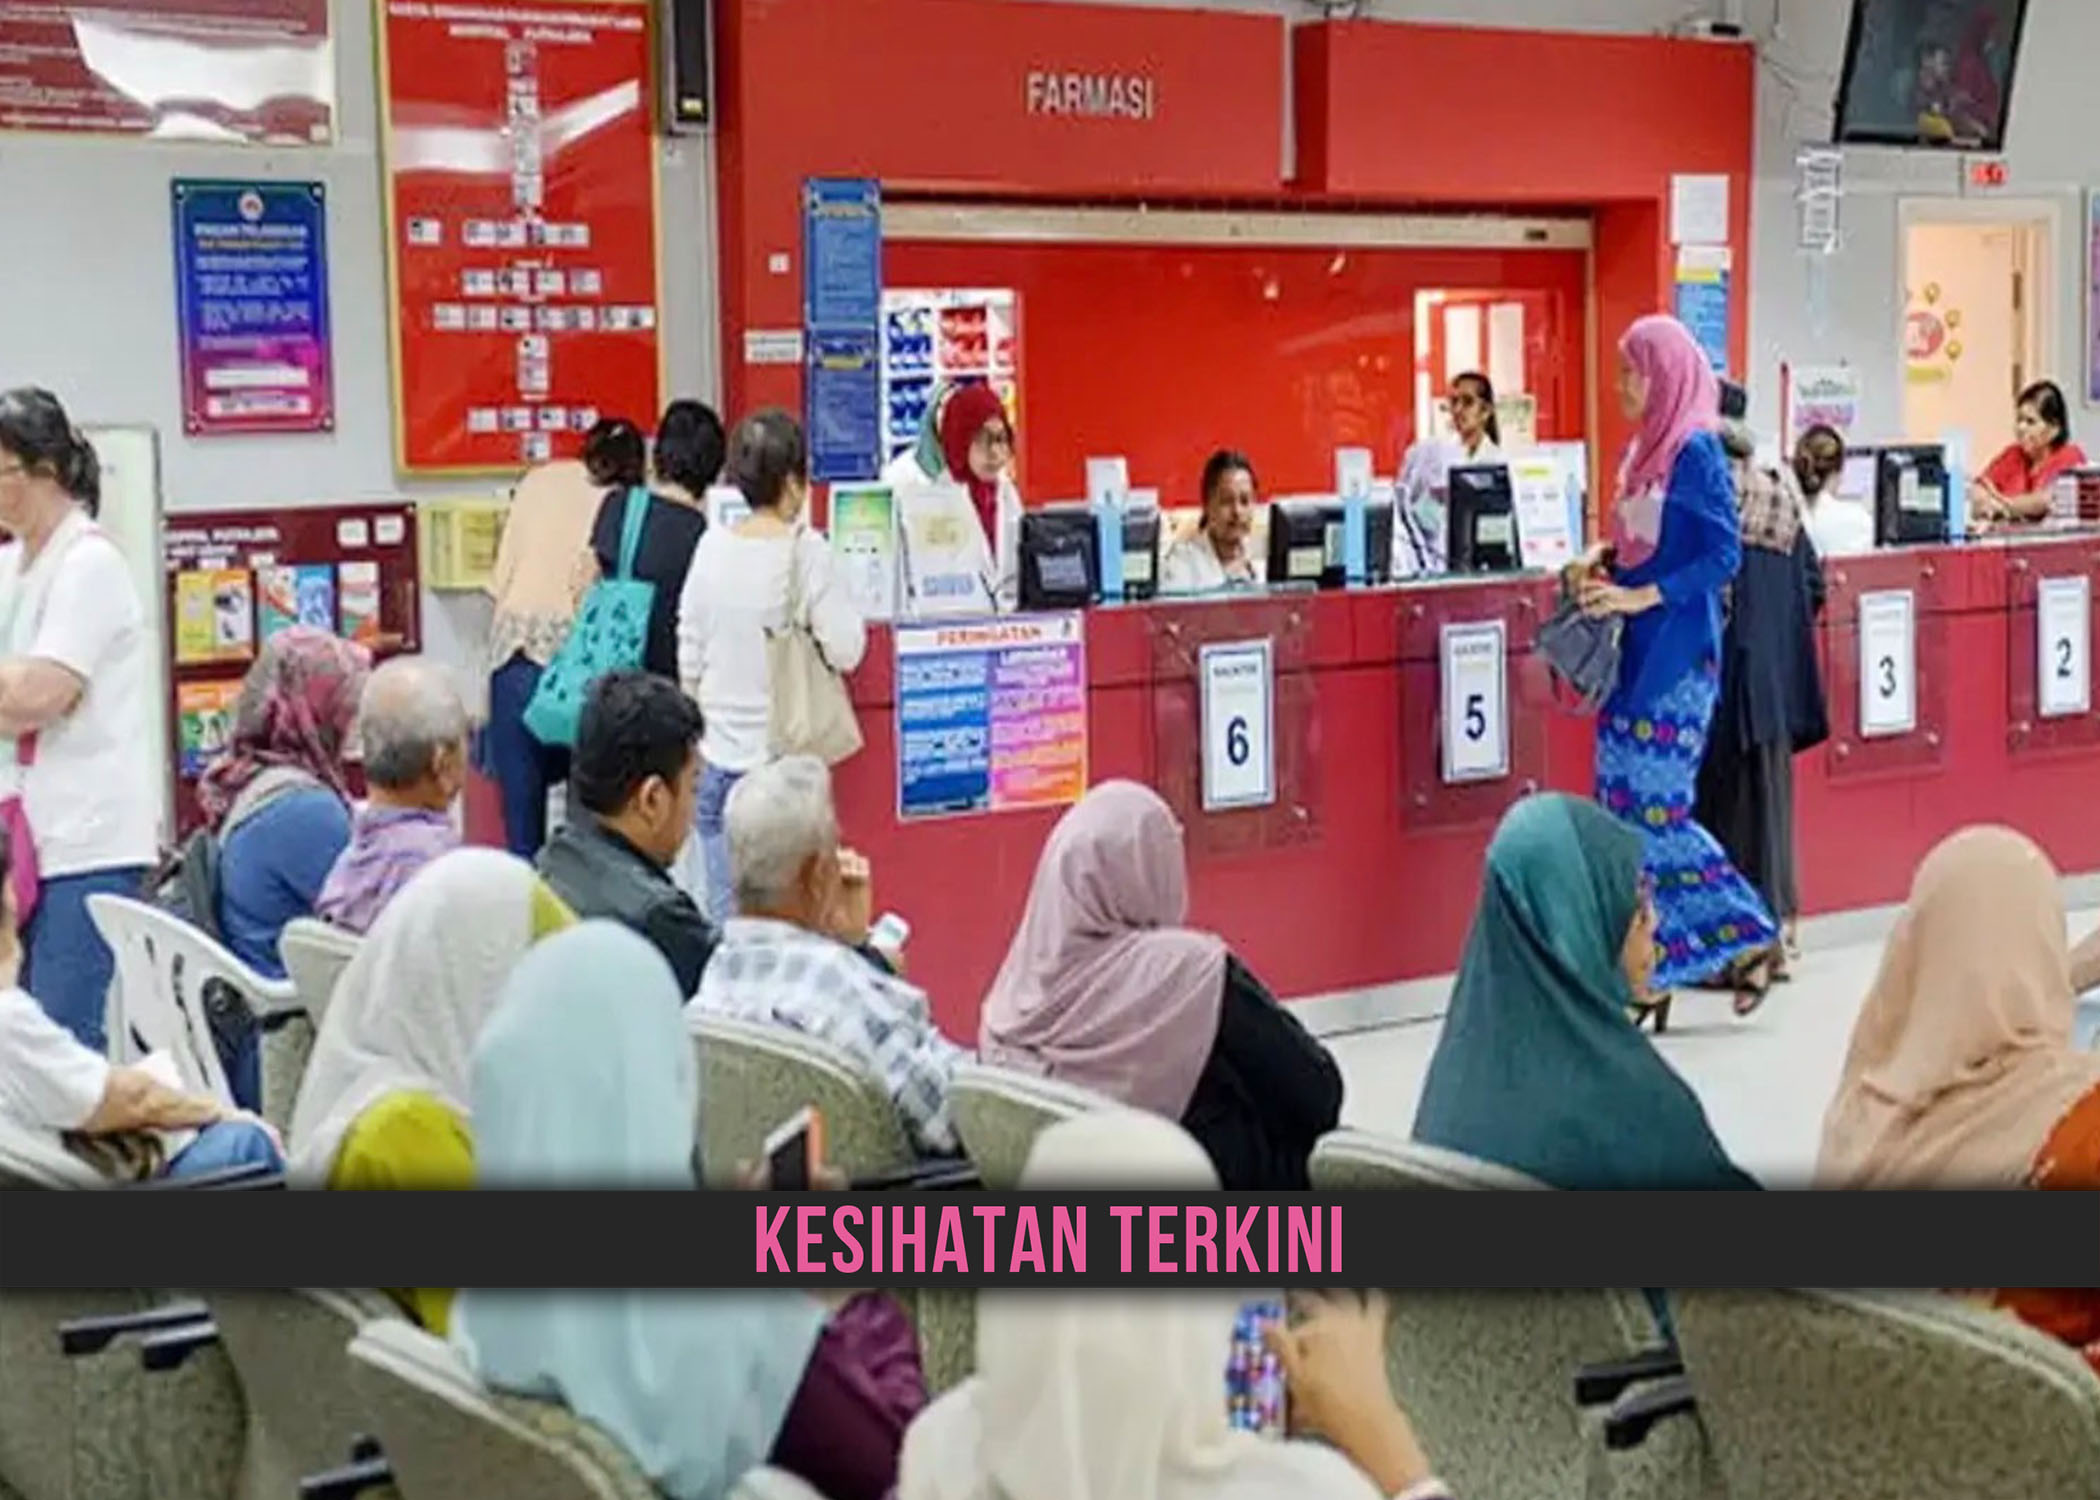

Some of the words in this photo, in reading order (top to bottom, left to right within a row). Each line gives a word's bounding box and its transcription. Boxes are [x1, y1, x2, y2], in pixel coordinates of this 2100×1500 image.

[1027, 72, 1153, 120] FARMASI
[1879, 655, 1897, 699] 3
[2056, 637, 2073, 678] 2
[1227, 715, 1250, 767] 6
[1465, 693, 1487, 742] 5
